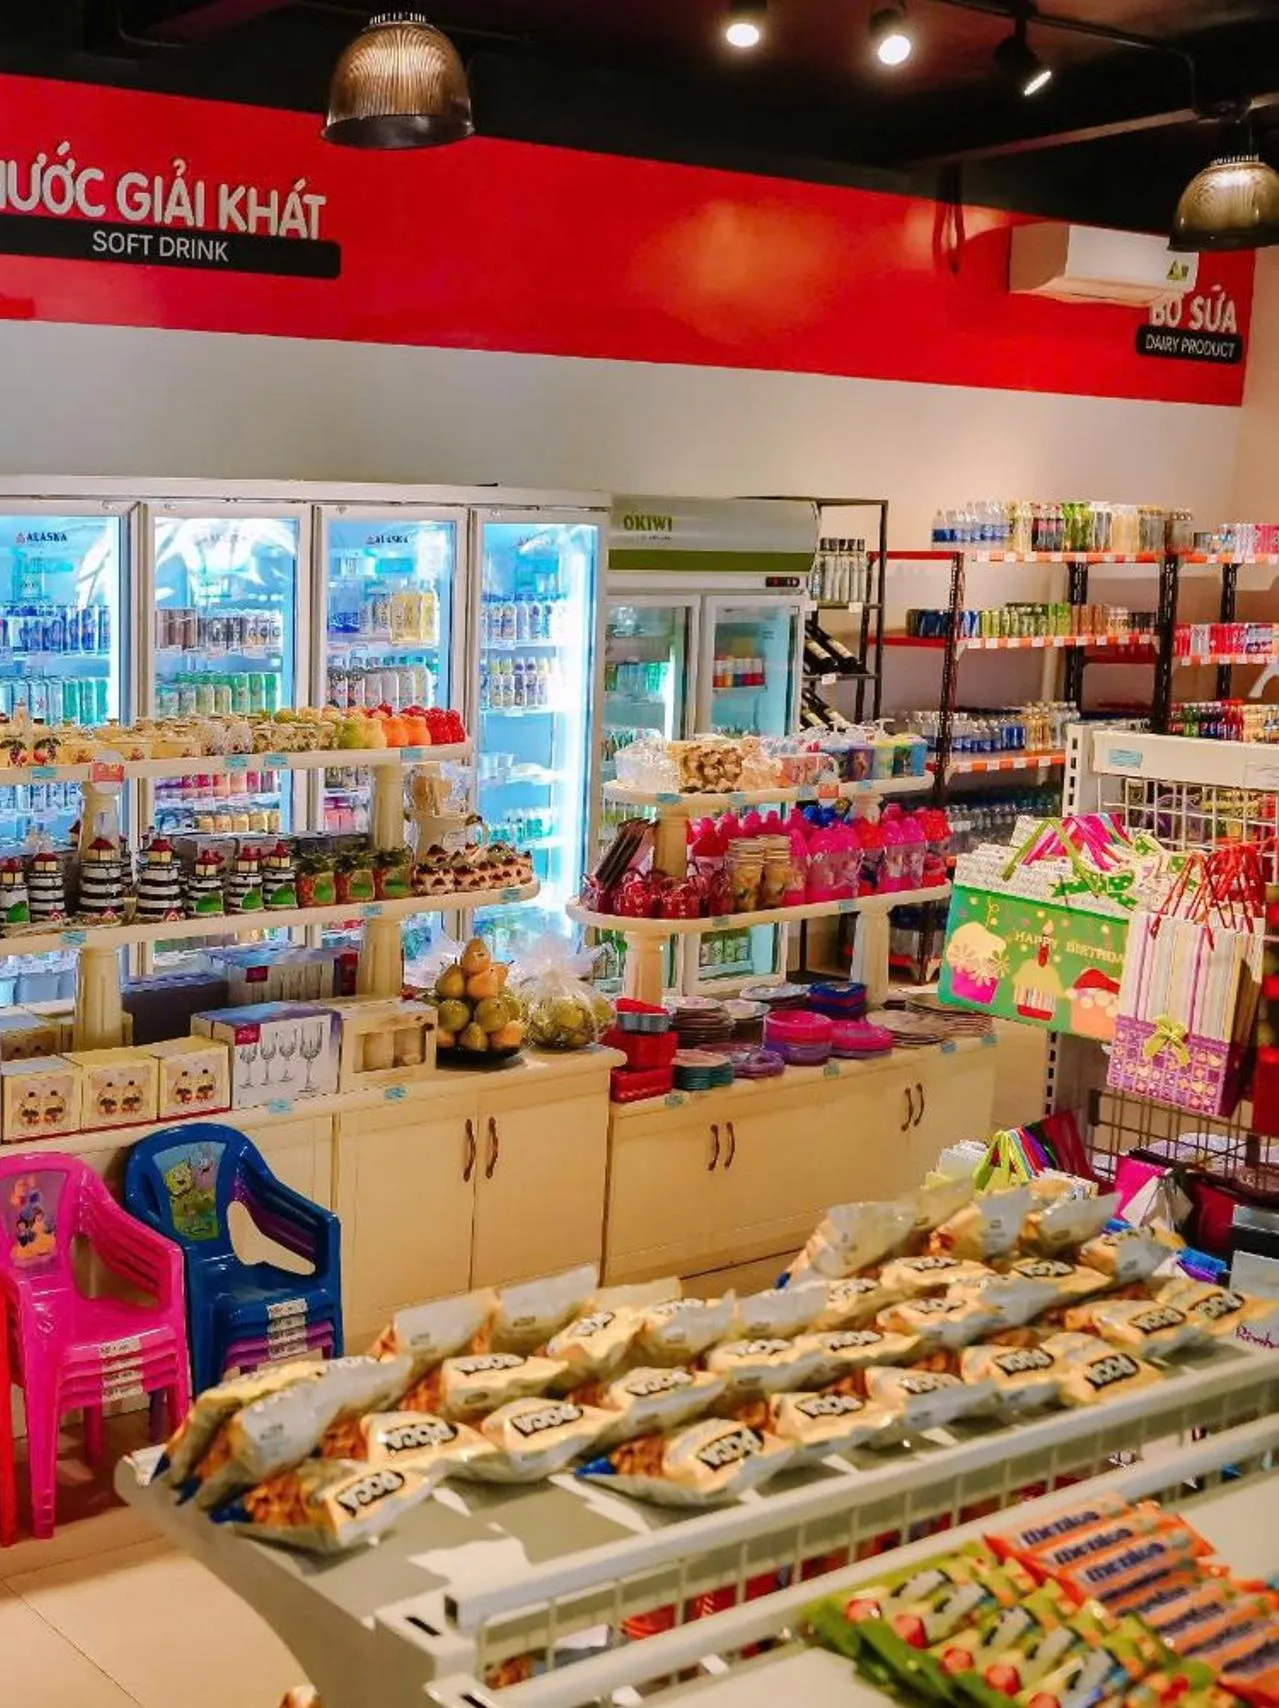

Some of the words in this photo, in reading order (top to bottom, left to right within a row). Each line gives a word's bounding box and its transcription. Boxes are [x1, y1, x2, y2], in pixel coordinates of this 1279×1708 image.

[116, 158, 205, 228] GIẢI
[220, 178, 327, 240] KHÁT
[91, 230, 153, 256] SOFT
[158, 236, 230, 262] DRINK
[1145, 333, 1179, 352] DAIRY
[1180, 337, 1237, 358] PRODUCT
[26, 532, 67, 542] ALASKA
[1015, 931, 1058, 950] HAPPY
[1021, 1511, 1100, 1546] mentos
[1053, 1528, 1133, 1565] mentos
[1085, 1543, 1166, 1582] mentos
